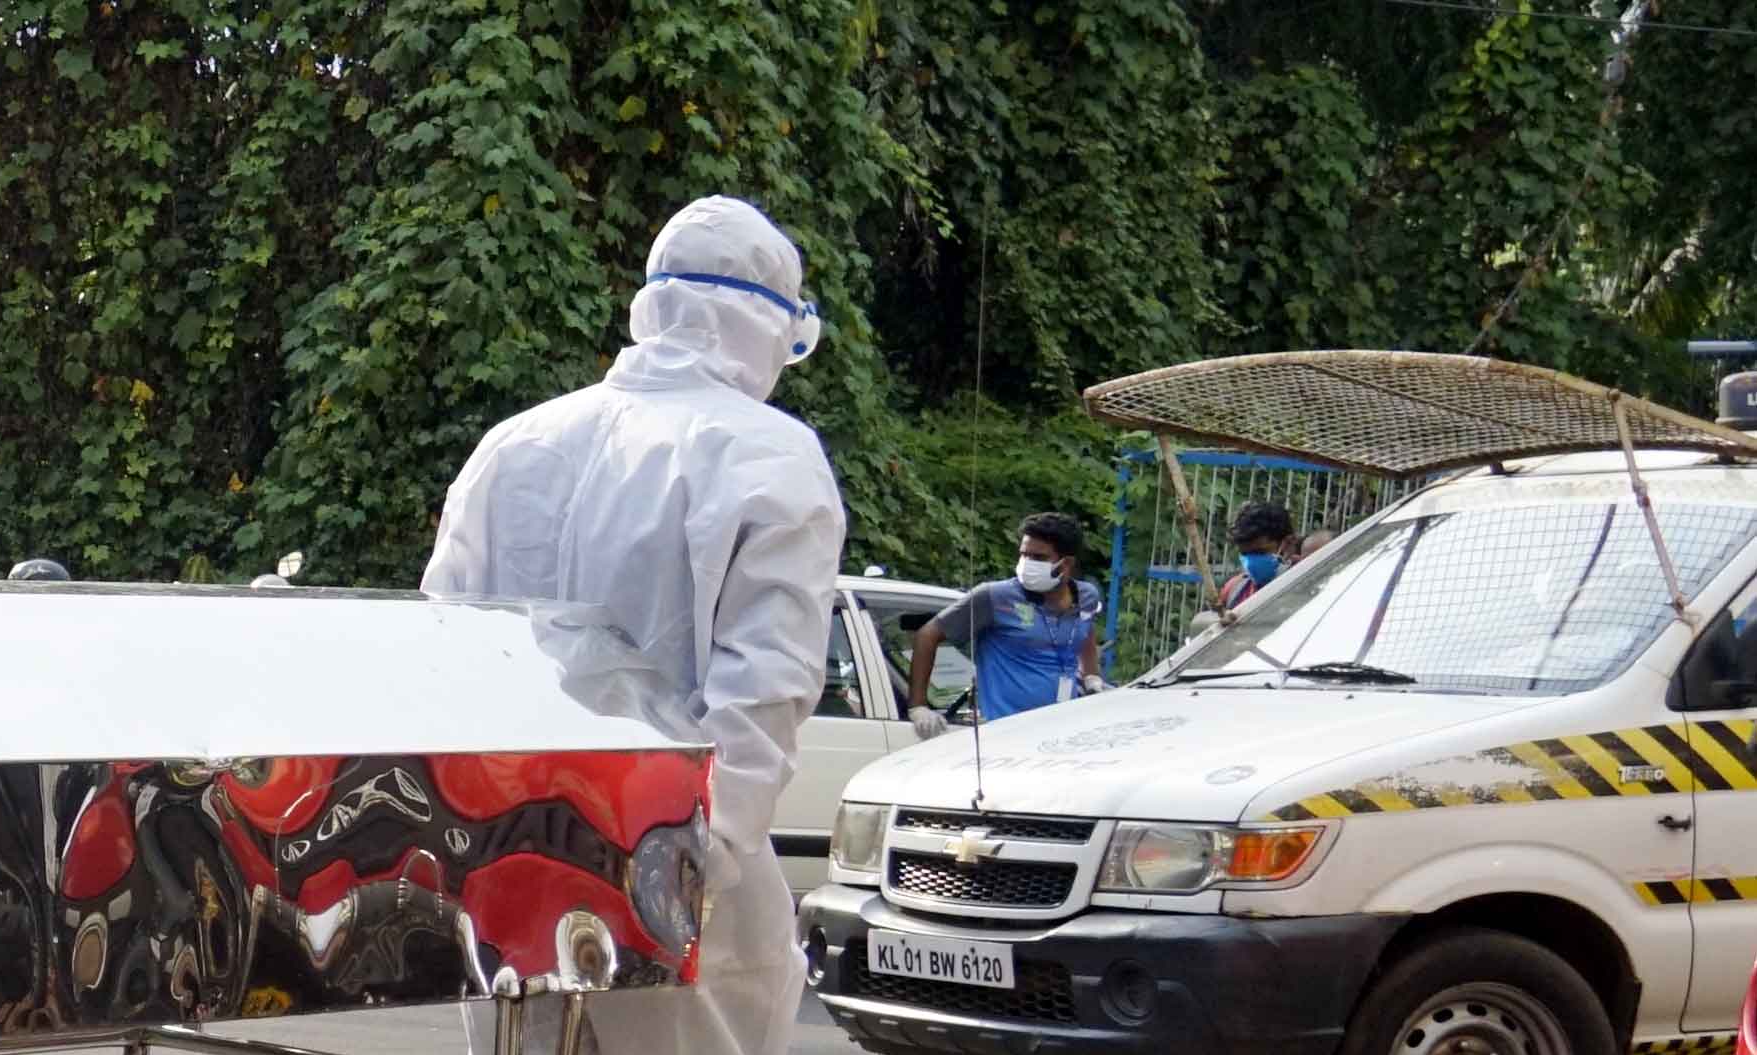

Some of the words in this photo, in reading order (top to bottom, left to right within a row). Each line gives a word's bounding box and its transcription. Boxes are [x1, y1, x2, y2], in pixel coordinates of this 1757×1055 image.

[878, 943, 900, 971] KL
[904, 947, 923, 974] 01
[929, 950, 956, 978] BW
[961, 954, 1003, 983] 6120
